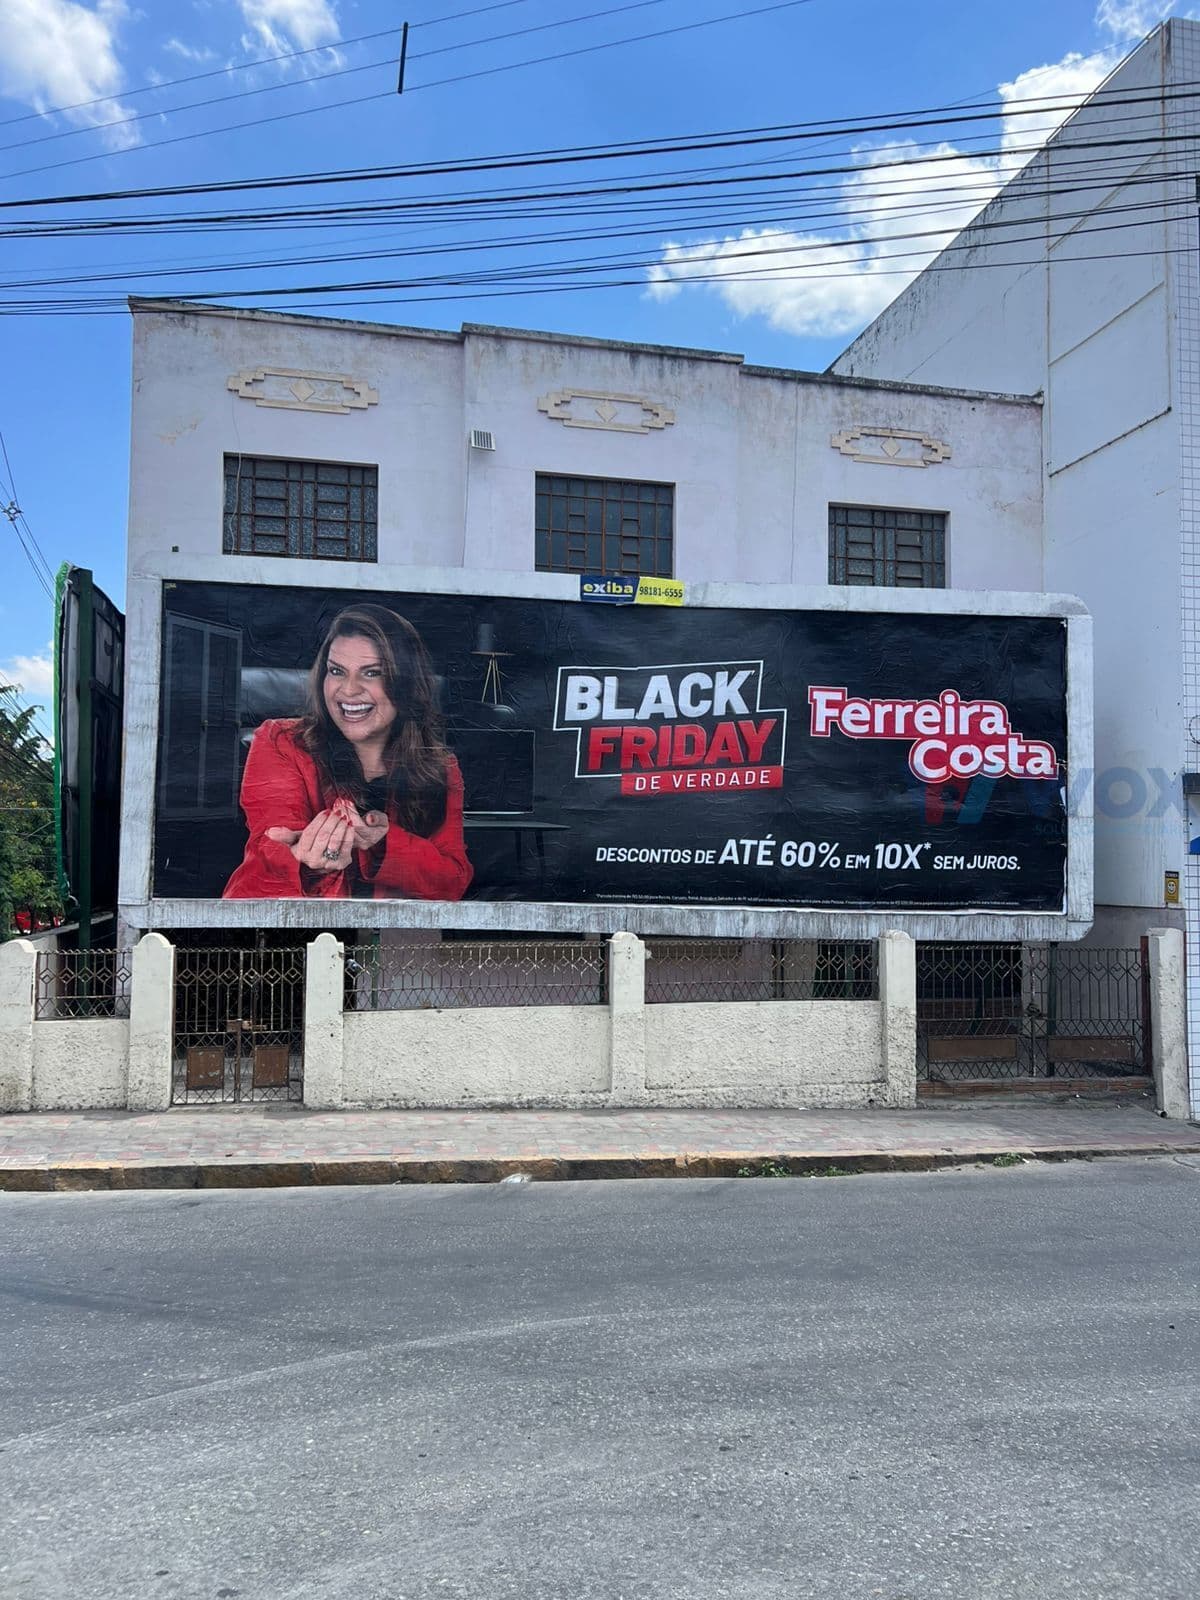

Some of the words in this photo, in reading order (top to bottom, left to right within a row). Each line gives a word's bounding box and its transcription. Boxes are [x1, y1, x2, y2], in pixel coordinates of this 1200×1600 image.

[583, 581, 634, 594] exiba
[640, 585, 683, 598] 98181-6555
[564, 669, 756, 721] BLACK
[811, 687, 1008, 736] Ferreira
[587, 718, 778, 771] FRIDAY
[912, 734, 1056, 780] Costa
[634, 775, 662, 791] DE
[672, 769, 772, 789] VERDADE
[595, 846, 692, 864] DESCONTOS
[694, 849, 717, 864] DE
[718, 833, 777, 867] ATÉ
[780, 840, 842, 869] 60%
[845, 854, 871, 870] EM
[933, 855, 964, 870] SEM
[966, 855, 1021, 870] JUROS.
